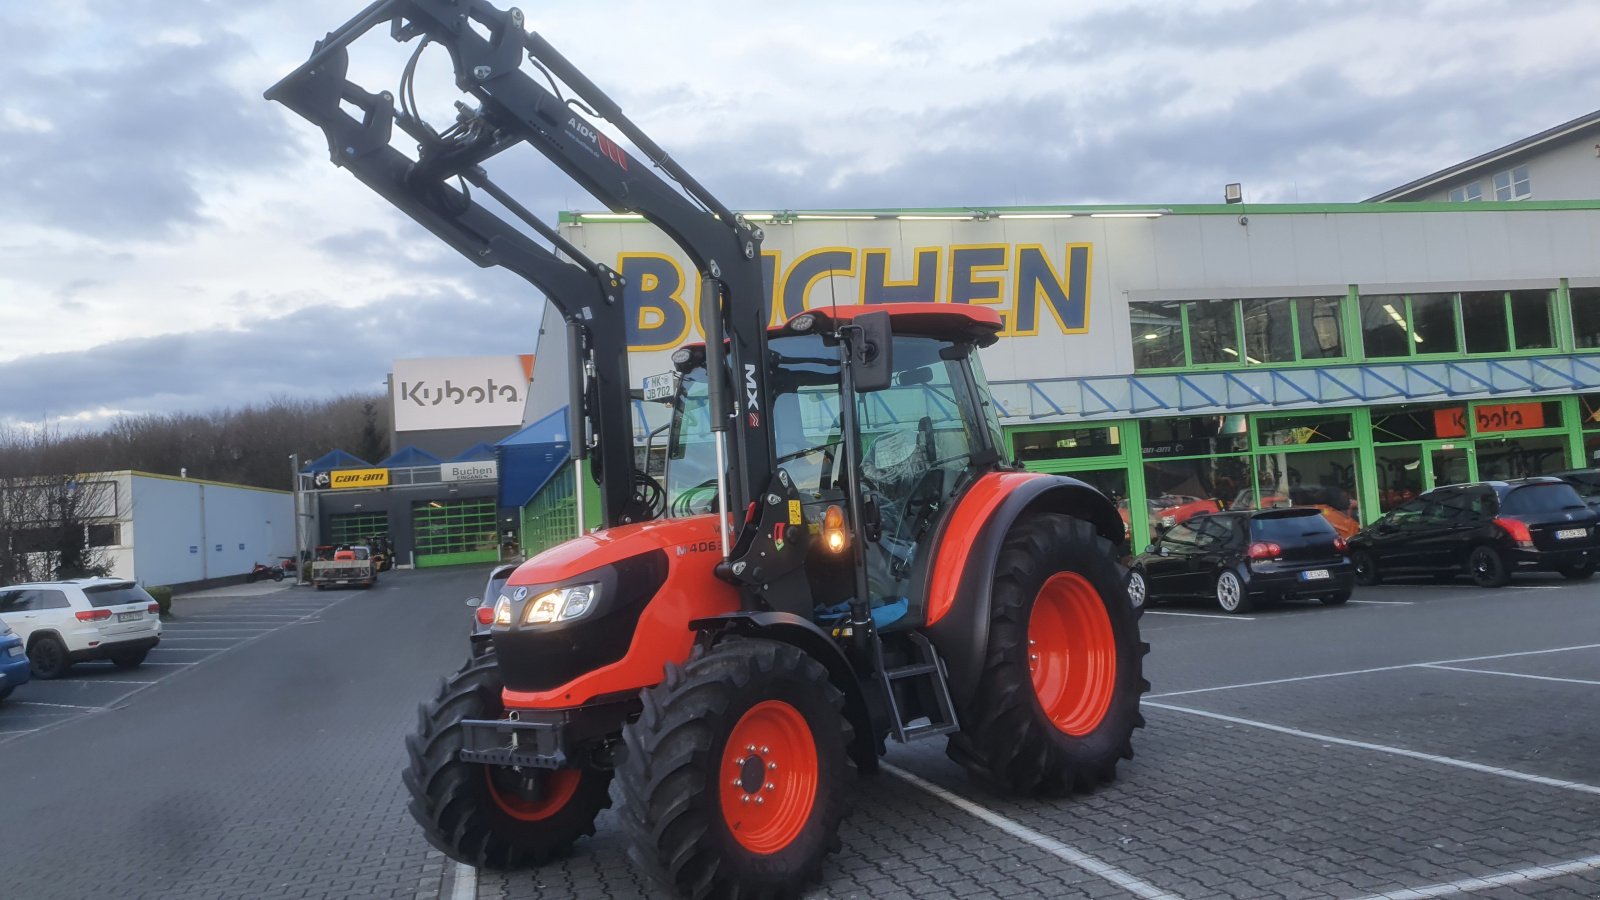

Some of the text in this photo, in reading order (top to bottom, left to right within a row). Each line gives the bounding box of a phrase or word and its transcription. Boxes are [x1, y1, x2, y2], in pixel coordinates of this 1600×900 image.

[401, 378, 518, 407] Kubota
[646, 386, 671, 400] JB 702
[744, 363, 759, 410] MX
[1452, 406, 1524, 429] Kbota
[334, 473, 385, 483] can-am
[452, 467, 493, 476] Buchen
